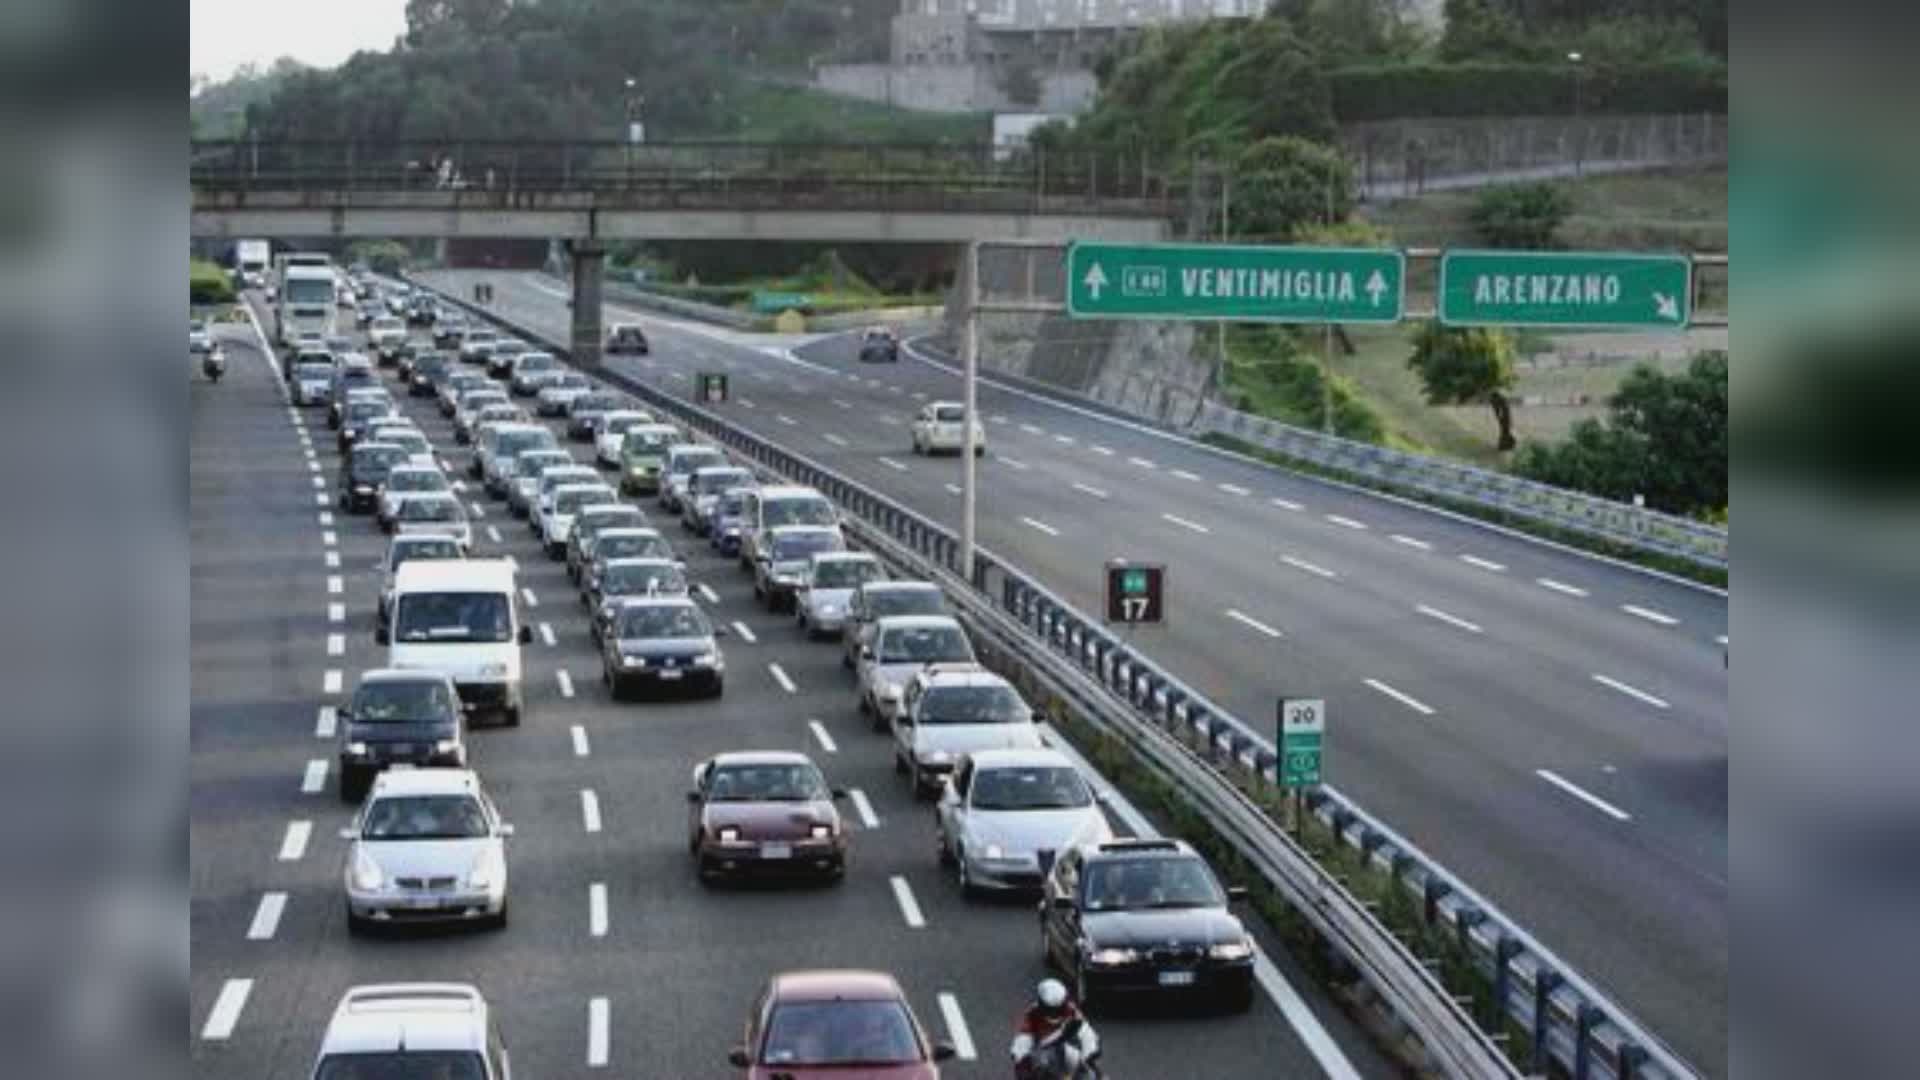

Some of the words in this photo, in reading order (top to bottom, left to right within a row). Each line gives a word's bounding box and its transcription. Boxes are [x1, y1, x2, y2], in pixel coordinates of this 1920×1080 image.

[1181, 267, 1355, 301] VENTIMIGLIA
[1475, 274, 1620, 304] ARENZANO
[1122, 598, 1149, 620] 17
